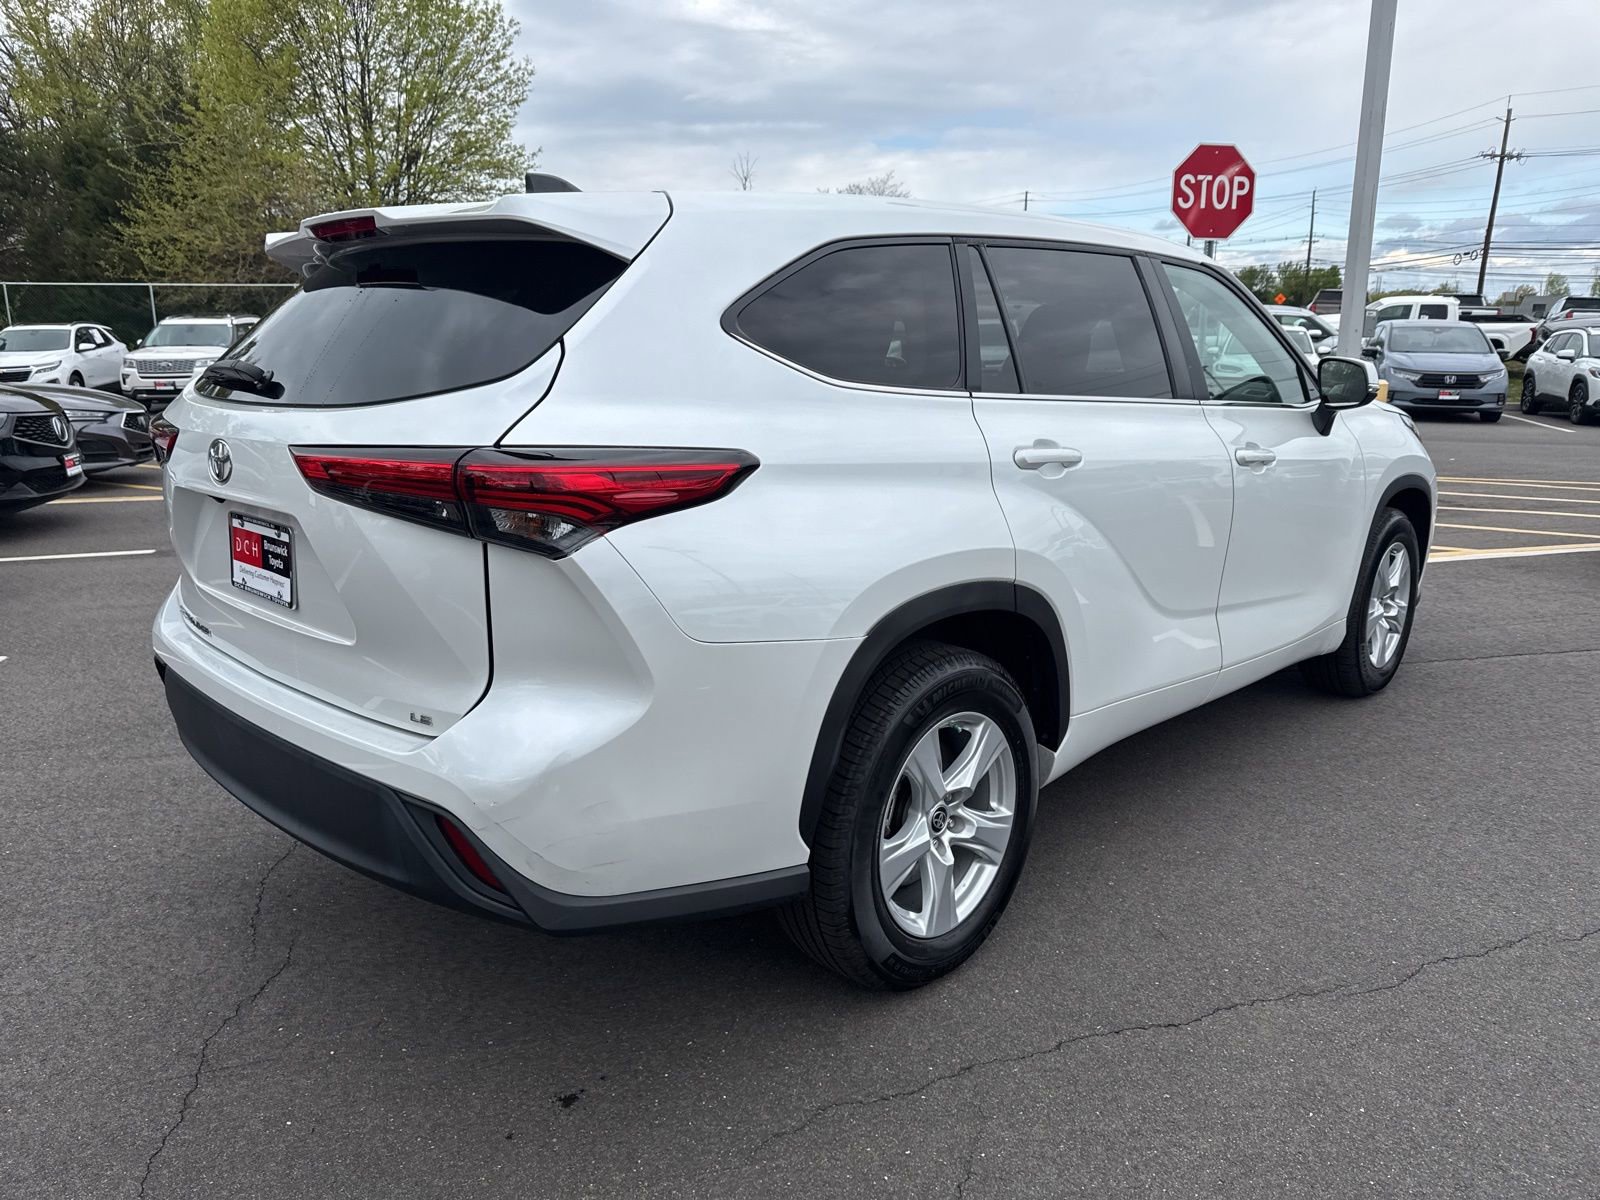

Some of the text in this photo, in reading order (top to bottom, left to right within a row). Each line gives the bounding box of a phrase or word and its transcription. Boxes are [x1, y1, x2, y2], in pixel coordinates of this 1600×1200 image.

[1177, 173, 1250, 210] STOP
[235, 537, 259, 558] DCH
[263, 540, 289, 557] Brunswick
[268, 554, 284, 570] Toyota
[410, 712, 433, 727] LE
